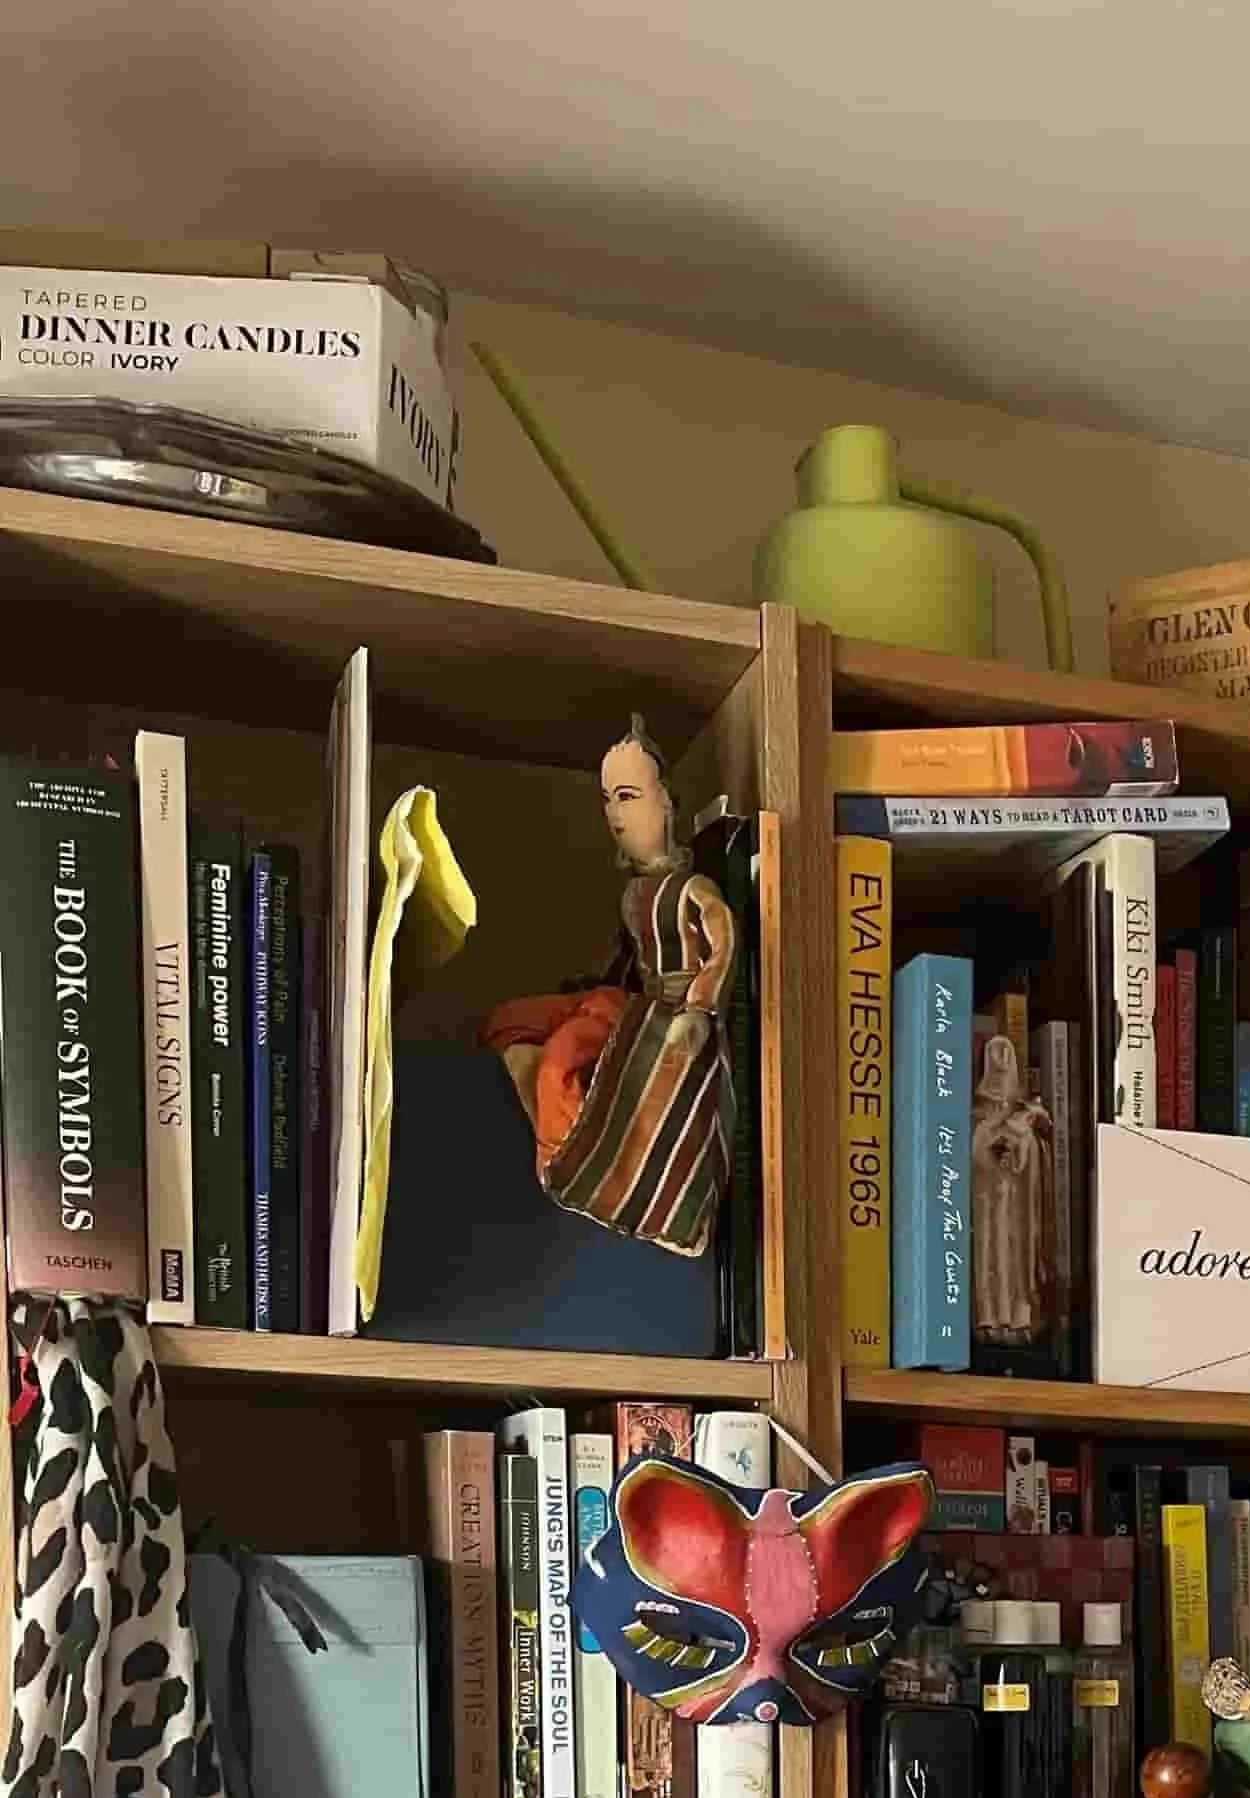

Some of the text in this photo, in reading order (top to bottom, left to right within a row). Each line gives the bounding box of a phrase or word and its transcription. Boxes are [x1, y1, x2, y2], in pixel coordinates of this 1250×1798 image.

[19, 313, 361, 359] DINNER CANDLES
[23, 288, 148, 313] TAPERED
[18, 347, 180, 373] COLOR IVORY
[388, 362, 446, 490] IVORY
[1146, 603, 1241, 648] GLEN
[929, 808, 947, 825] 21
[953, 807, 1003, 825] WAYS
[1060, 807, 1120, 825] TAROT
[1121, 807, 1169, 824] CARD
[211, 862, 233, 970] Feminine
[1126, 895, 1150, 955] Kiki
[53, 839, 94, 1232] THE BOOK OF SYMBOLS
[208, 974, 231, 1049] power
[935, 983, 954, 1034] Karla
[1126, 963, 1152, 1051] Smith
[155, 1034, 185, 1129] SIGNS
[848, 872, 882, 1229] EVA HESSE 1965
[45, 1254, 113, 1272] TASCHEN
[849, 1329, 881, 1346] Yale
[458, 1483, 487, 1729] CREATION MYTHS
[545, 1475, 569, 1755] JUNG'S MAP OF THE SOUL
[517, 1630, 536, 1722] Inner Work
